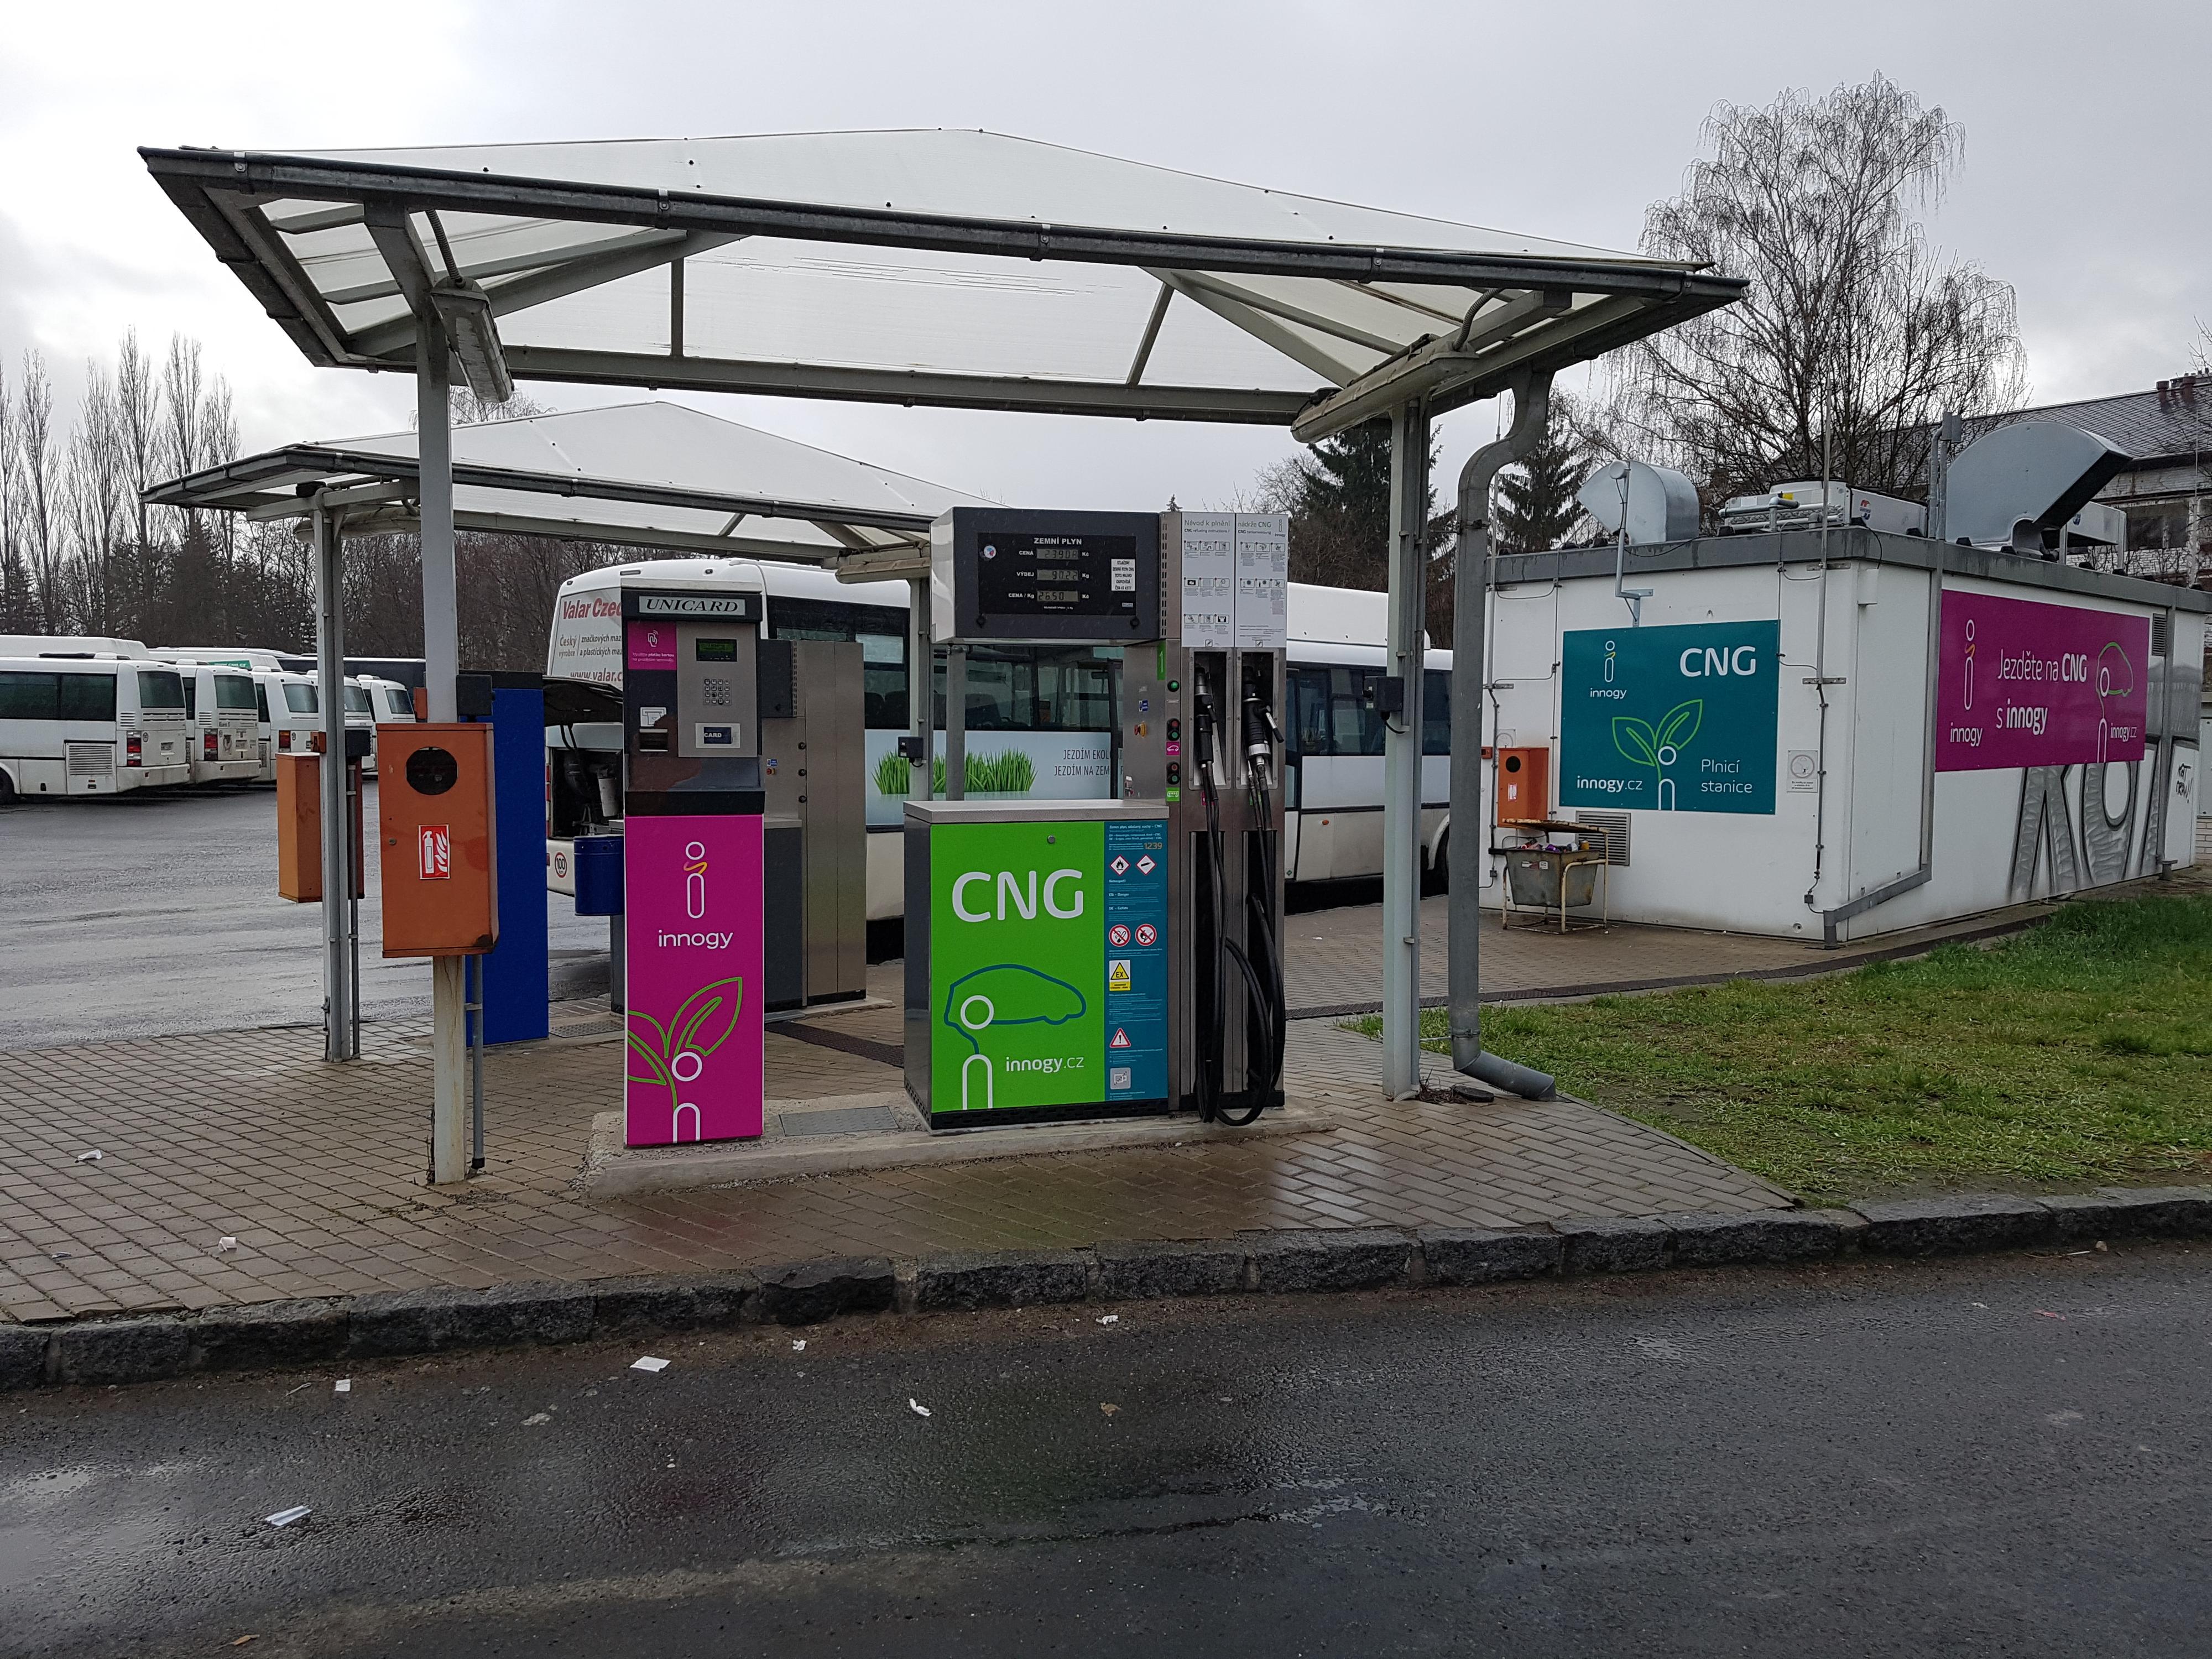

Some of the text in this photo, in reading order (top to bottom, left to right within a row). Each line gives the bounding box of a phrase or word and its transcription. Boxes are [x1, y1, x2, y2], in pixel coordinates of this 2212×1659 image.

[563, 600, 592, 619] Valar
[646, 599, 738, 612] UNICARD
[560, 634, 577, 648] Český
[581, 634, 609, 644] značkových
[559, 649, 575, 659] výrobce
[583, 647, 611, 658] plastických
[1680, 646, 1756, 677] CNG
[1997, 649, 2087, 682] Jezděte na CNG
[1590, 687, 1627, 699] innogy
[1996, 698, 2048, 735] s innogy
[1950, 722, 1983, 747] innogy
[2110, 723, 2137, 742] innogy.cz
[1063, 747, 1090, 760] JEZDÍM
[1054, 764, 1082, 776] JEZDÍM
[1084, 766, 1093, 775] NA
[1702, 759, 1740, 773] Plnicí
[1577, 775, 1642, 792] innogy.cz
[1700, 780, 1752, 793] stanice
[556, 858, 565, 869] 100
[952, 869, 1083, 922] CNG
[658, 930, 733, 949] innogy
[1006, 1057, 1084, 1073] innogy.cz
